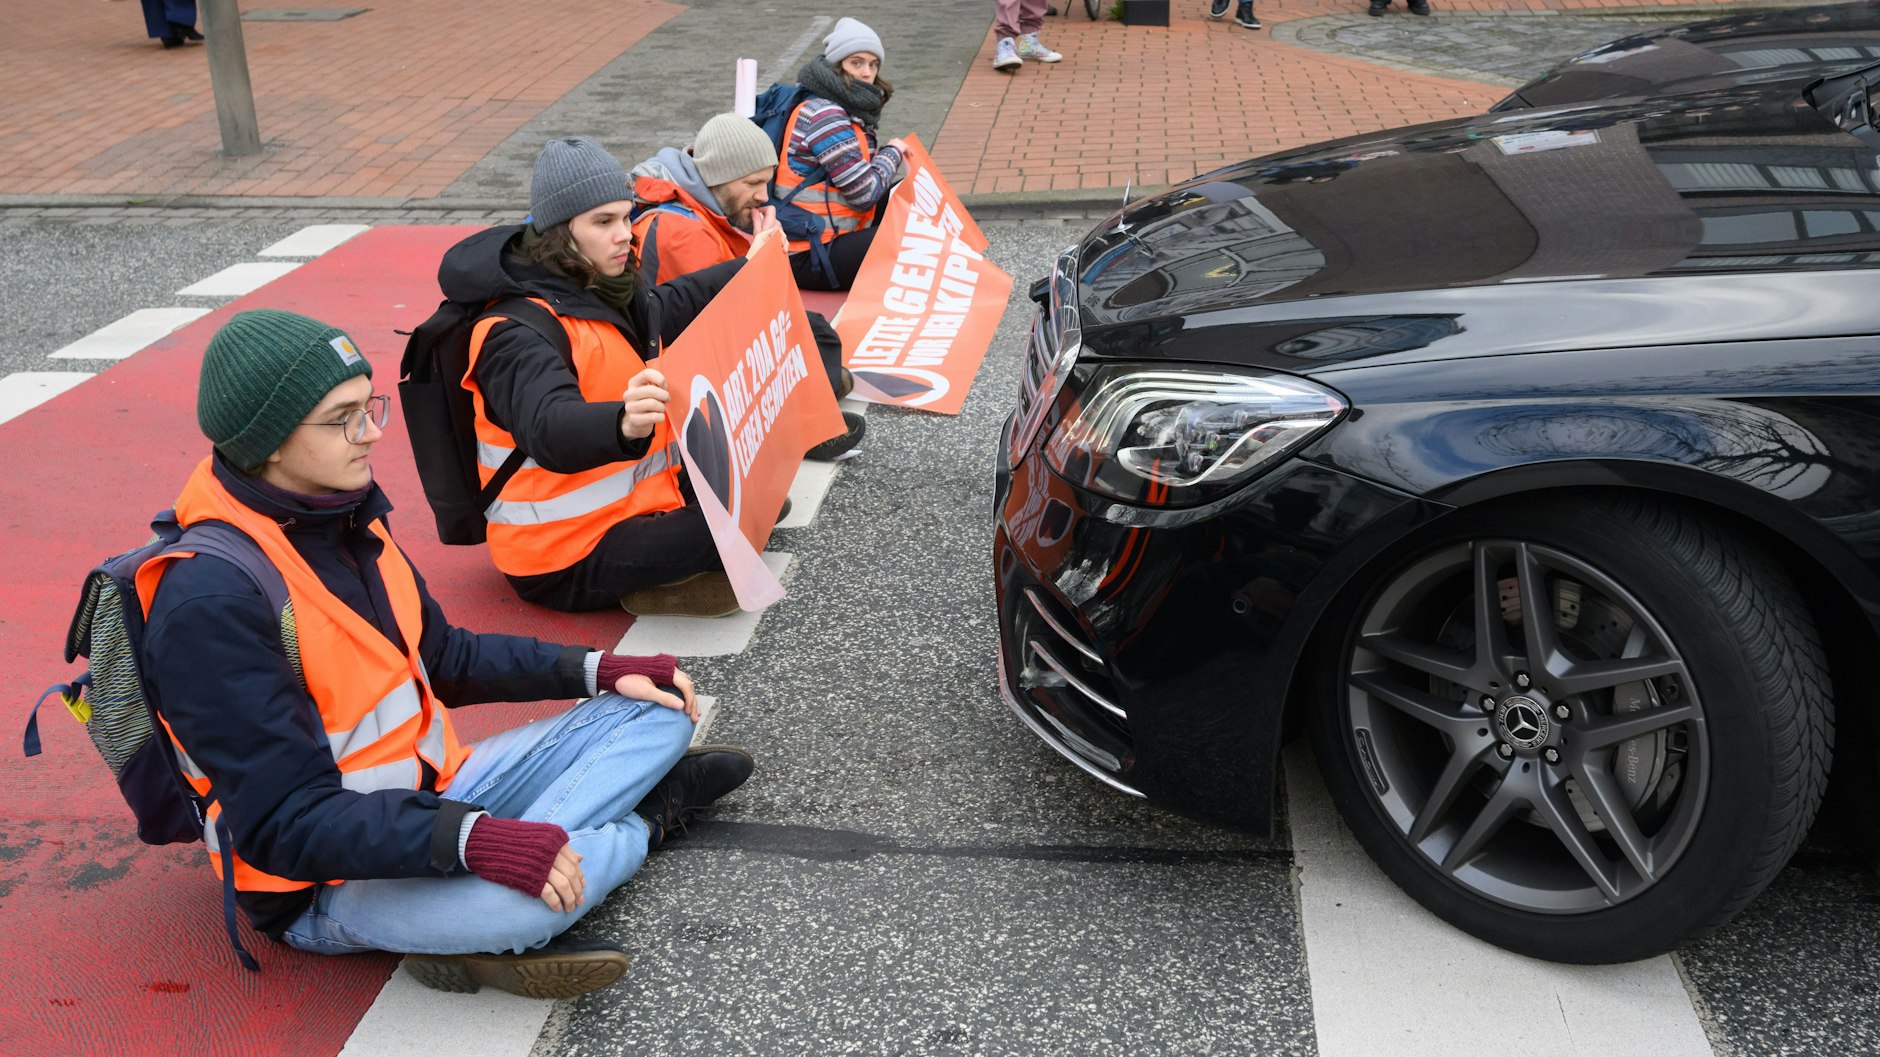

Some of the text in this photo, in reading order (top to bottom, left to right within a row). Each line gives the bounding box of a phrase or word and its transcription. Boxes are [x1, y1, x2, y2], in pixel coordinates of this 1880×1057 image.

[848, 316, 920, 365] LETZTE
[919, 314, 966, 337] DEN
[902, 338, 953, 366] VOR
[723, 359, 753, 433] ART.
[746, 329, 775, 396] 20A
[735, 343, 808, 479] LEBEN SCHÜTZEN
